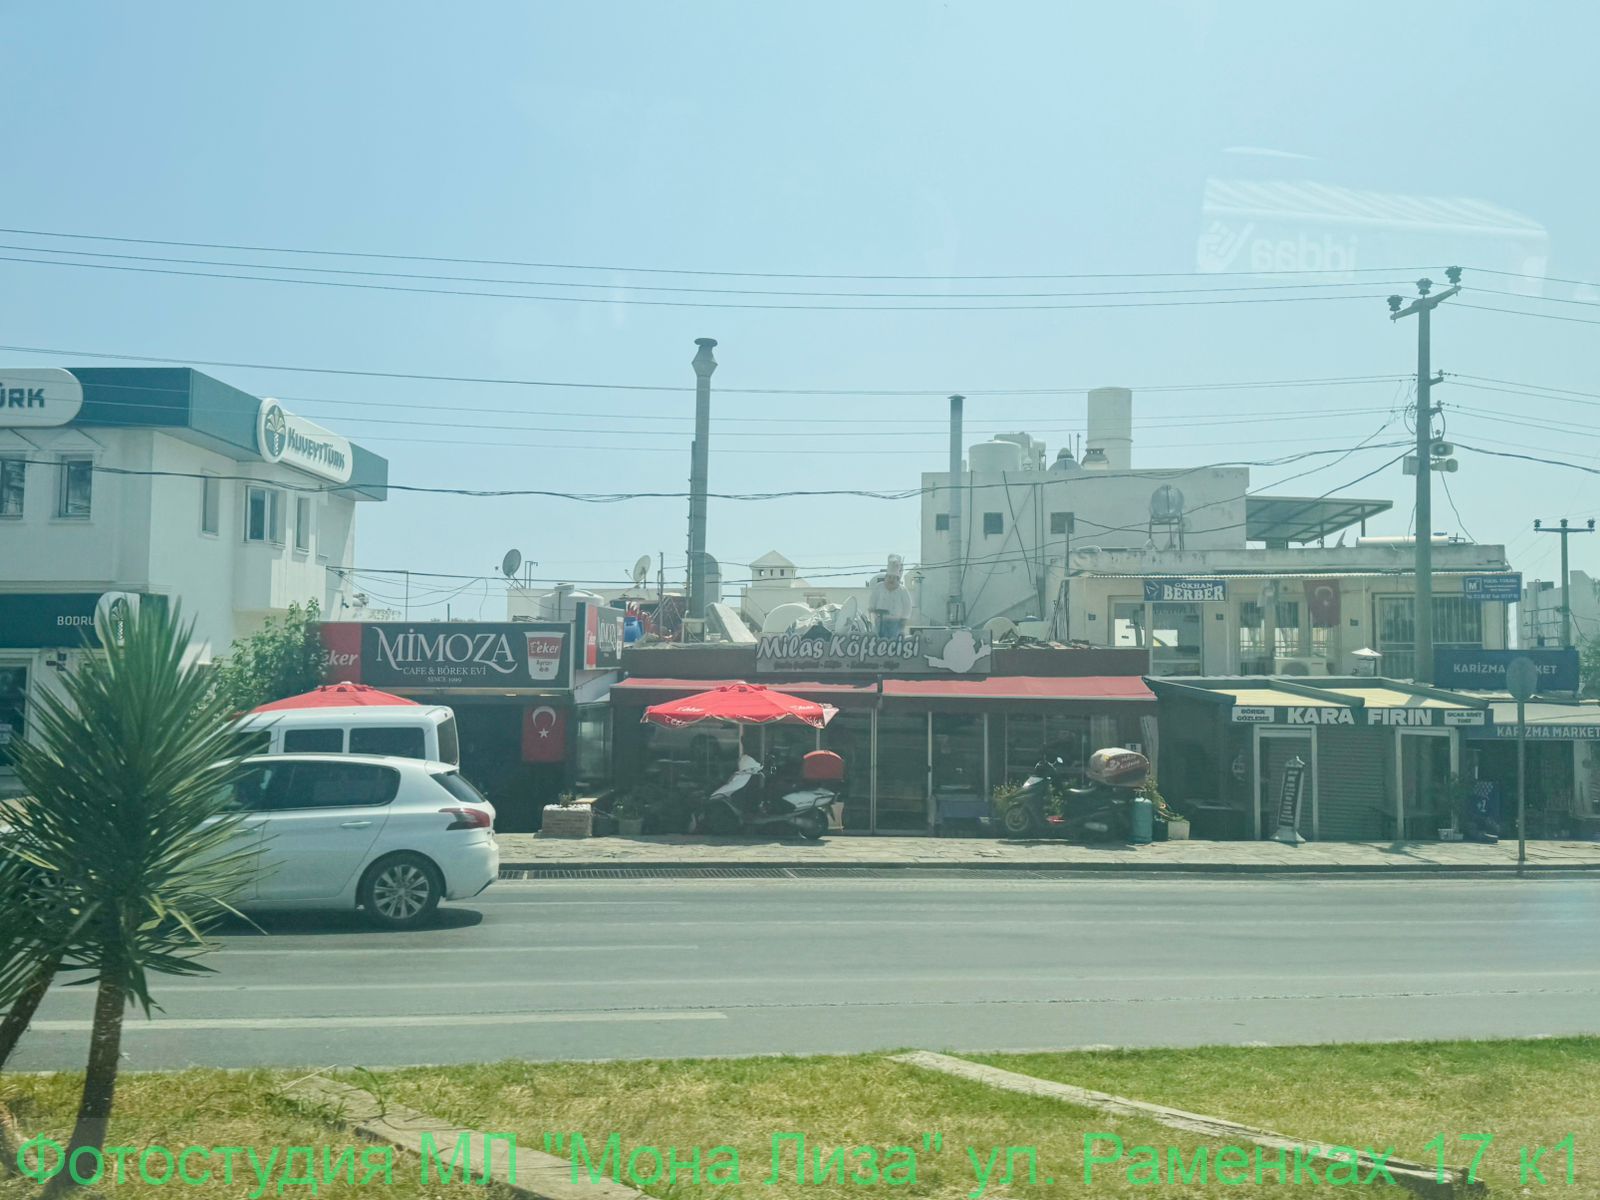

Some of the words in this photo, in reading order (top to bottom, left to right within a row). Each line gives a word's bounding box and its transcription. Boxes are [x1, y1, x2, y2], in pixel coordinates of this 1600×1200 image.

[1163, 584, 1224, 601] BERBER
[57, 615, 95, 626] BODRU
[371, 626, 519, 674] MİMOZA
[756, 635, 824, 660] Milas
[829, 634, 921, 662] Köftecisi
[403, 666, 426, 675] CAFE
[428, 667, 435, 675] &
[437, 664, 469, 675] BÖREK
[470, 664, 487, 675] EVİ
[1454, 661, 1506, 674] KARİZMA
[1287, 708, 1355, 726] KARA
[1367, 708, 1433, 726] FIRIN
[1497, 725, 1550, 738] KARZMA
[1552, 726, 1600, 738] MARKET
